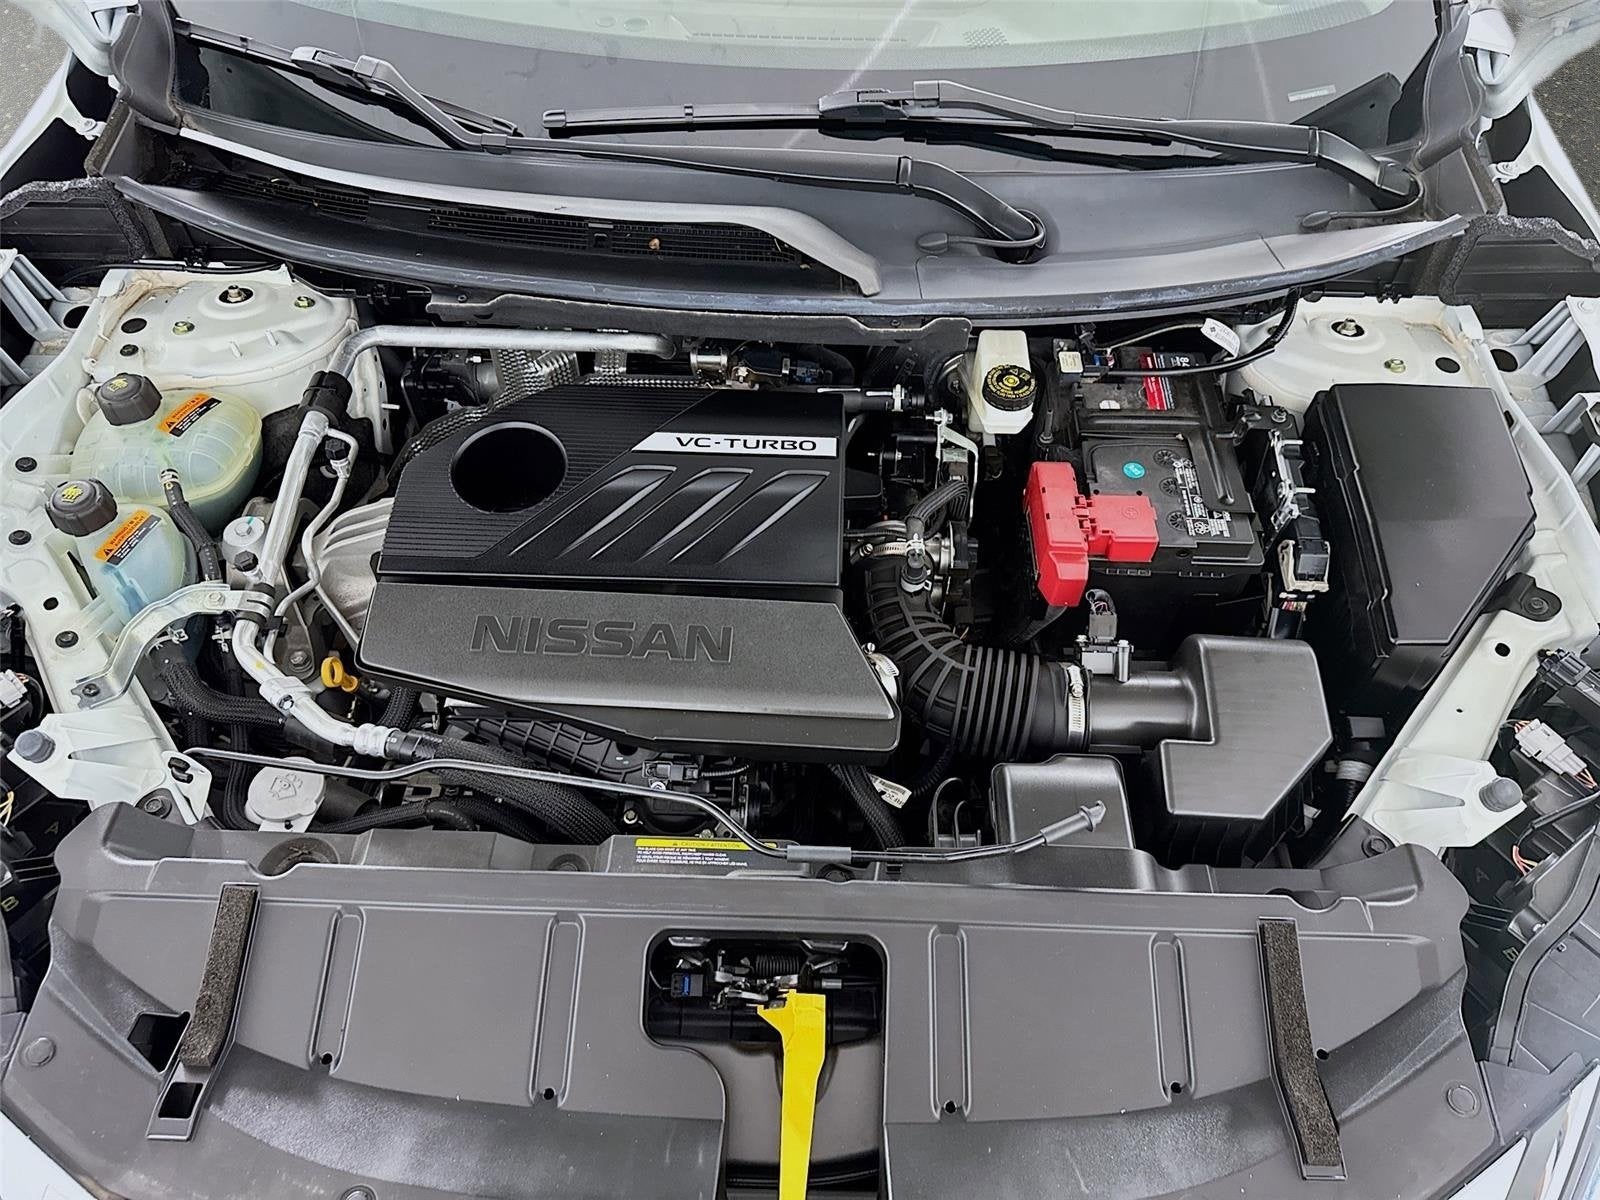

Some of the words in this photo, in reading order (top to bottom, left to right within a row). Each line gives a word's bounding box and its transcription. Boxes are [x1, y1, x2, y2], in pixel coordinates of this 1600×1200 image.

[676, 437, 816, 451] VC-TURBO
[470, 615, 734, 663] NISSAN
[1, 896, 19, 912] B
